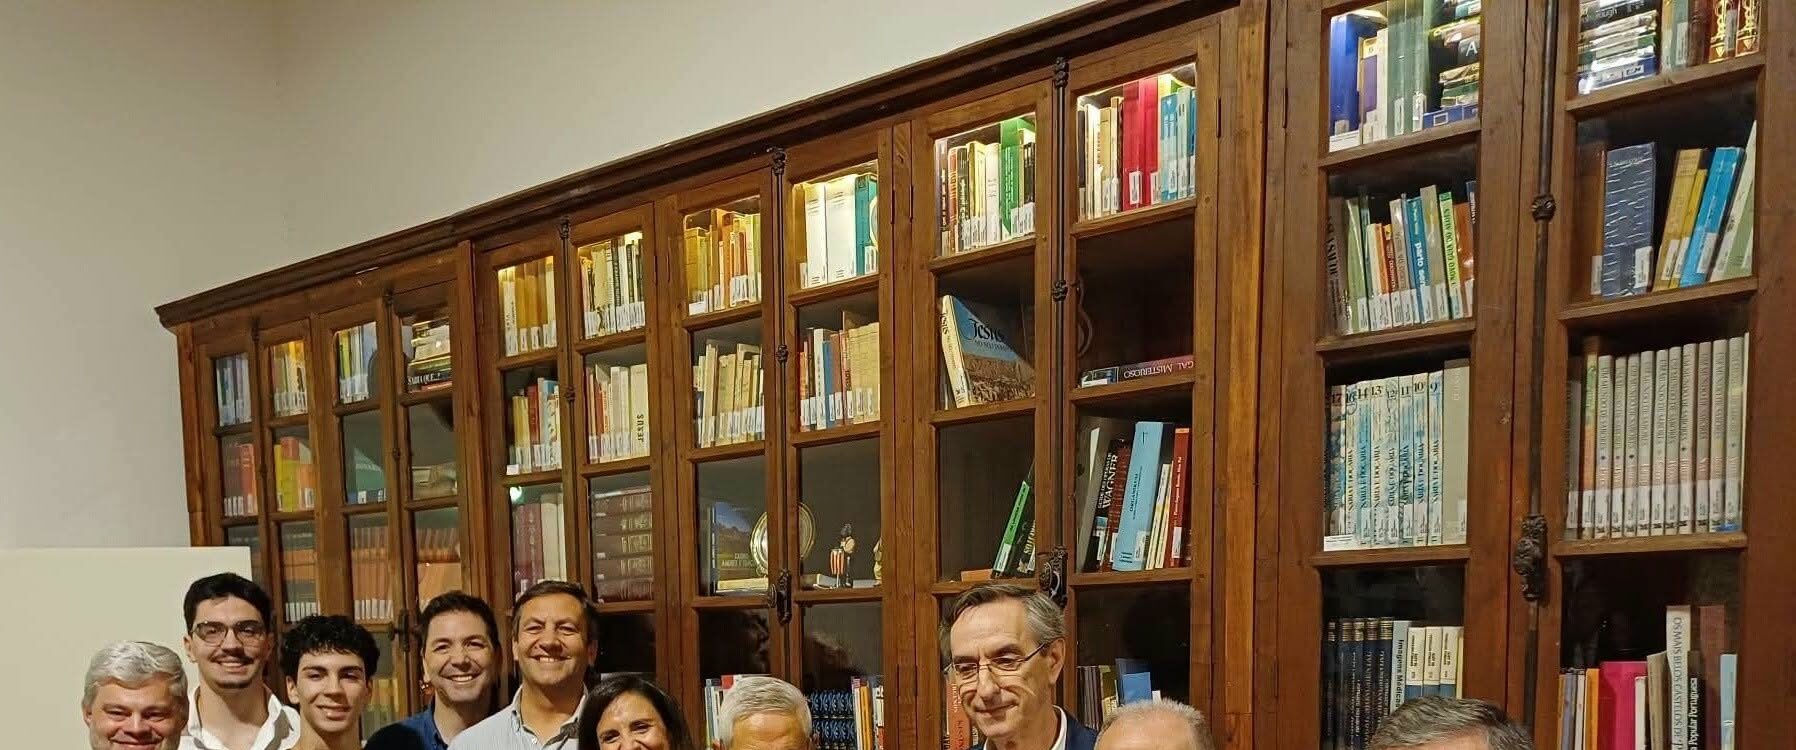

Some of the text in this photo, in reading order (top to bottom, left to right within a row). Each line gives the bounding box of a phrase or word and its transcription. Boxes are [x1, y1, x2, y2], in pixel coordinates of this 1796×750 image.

[1178, 360, 1194, 371] GAL
[636, 414, 645, 443] JESUS
[1102, 454, 1118, 508] WAGNER
[1688, 718, 1699, 745] Popular
